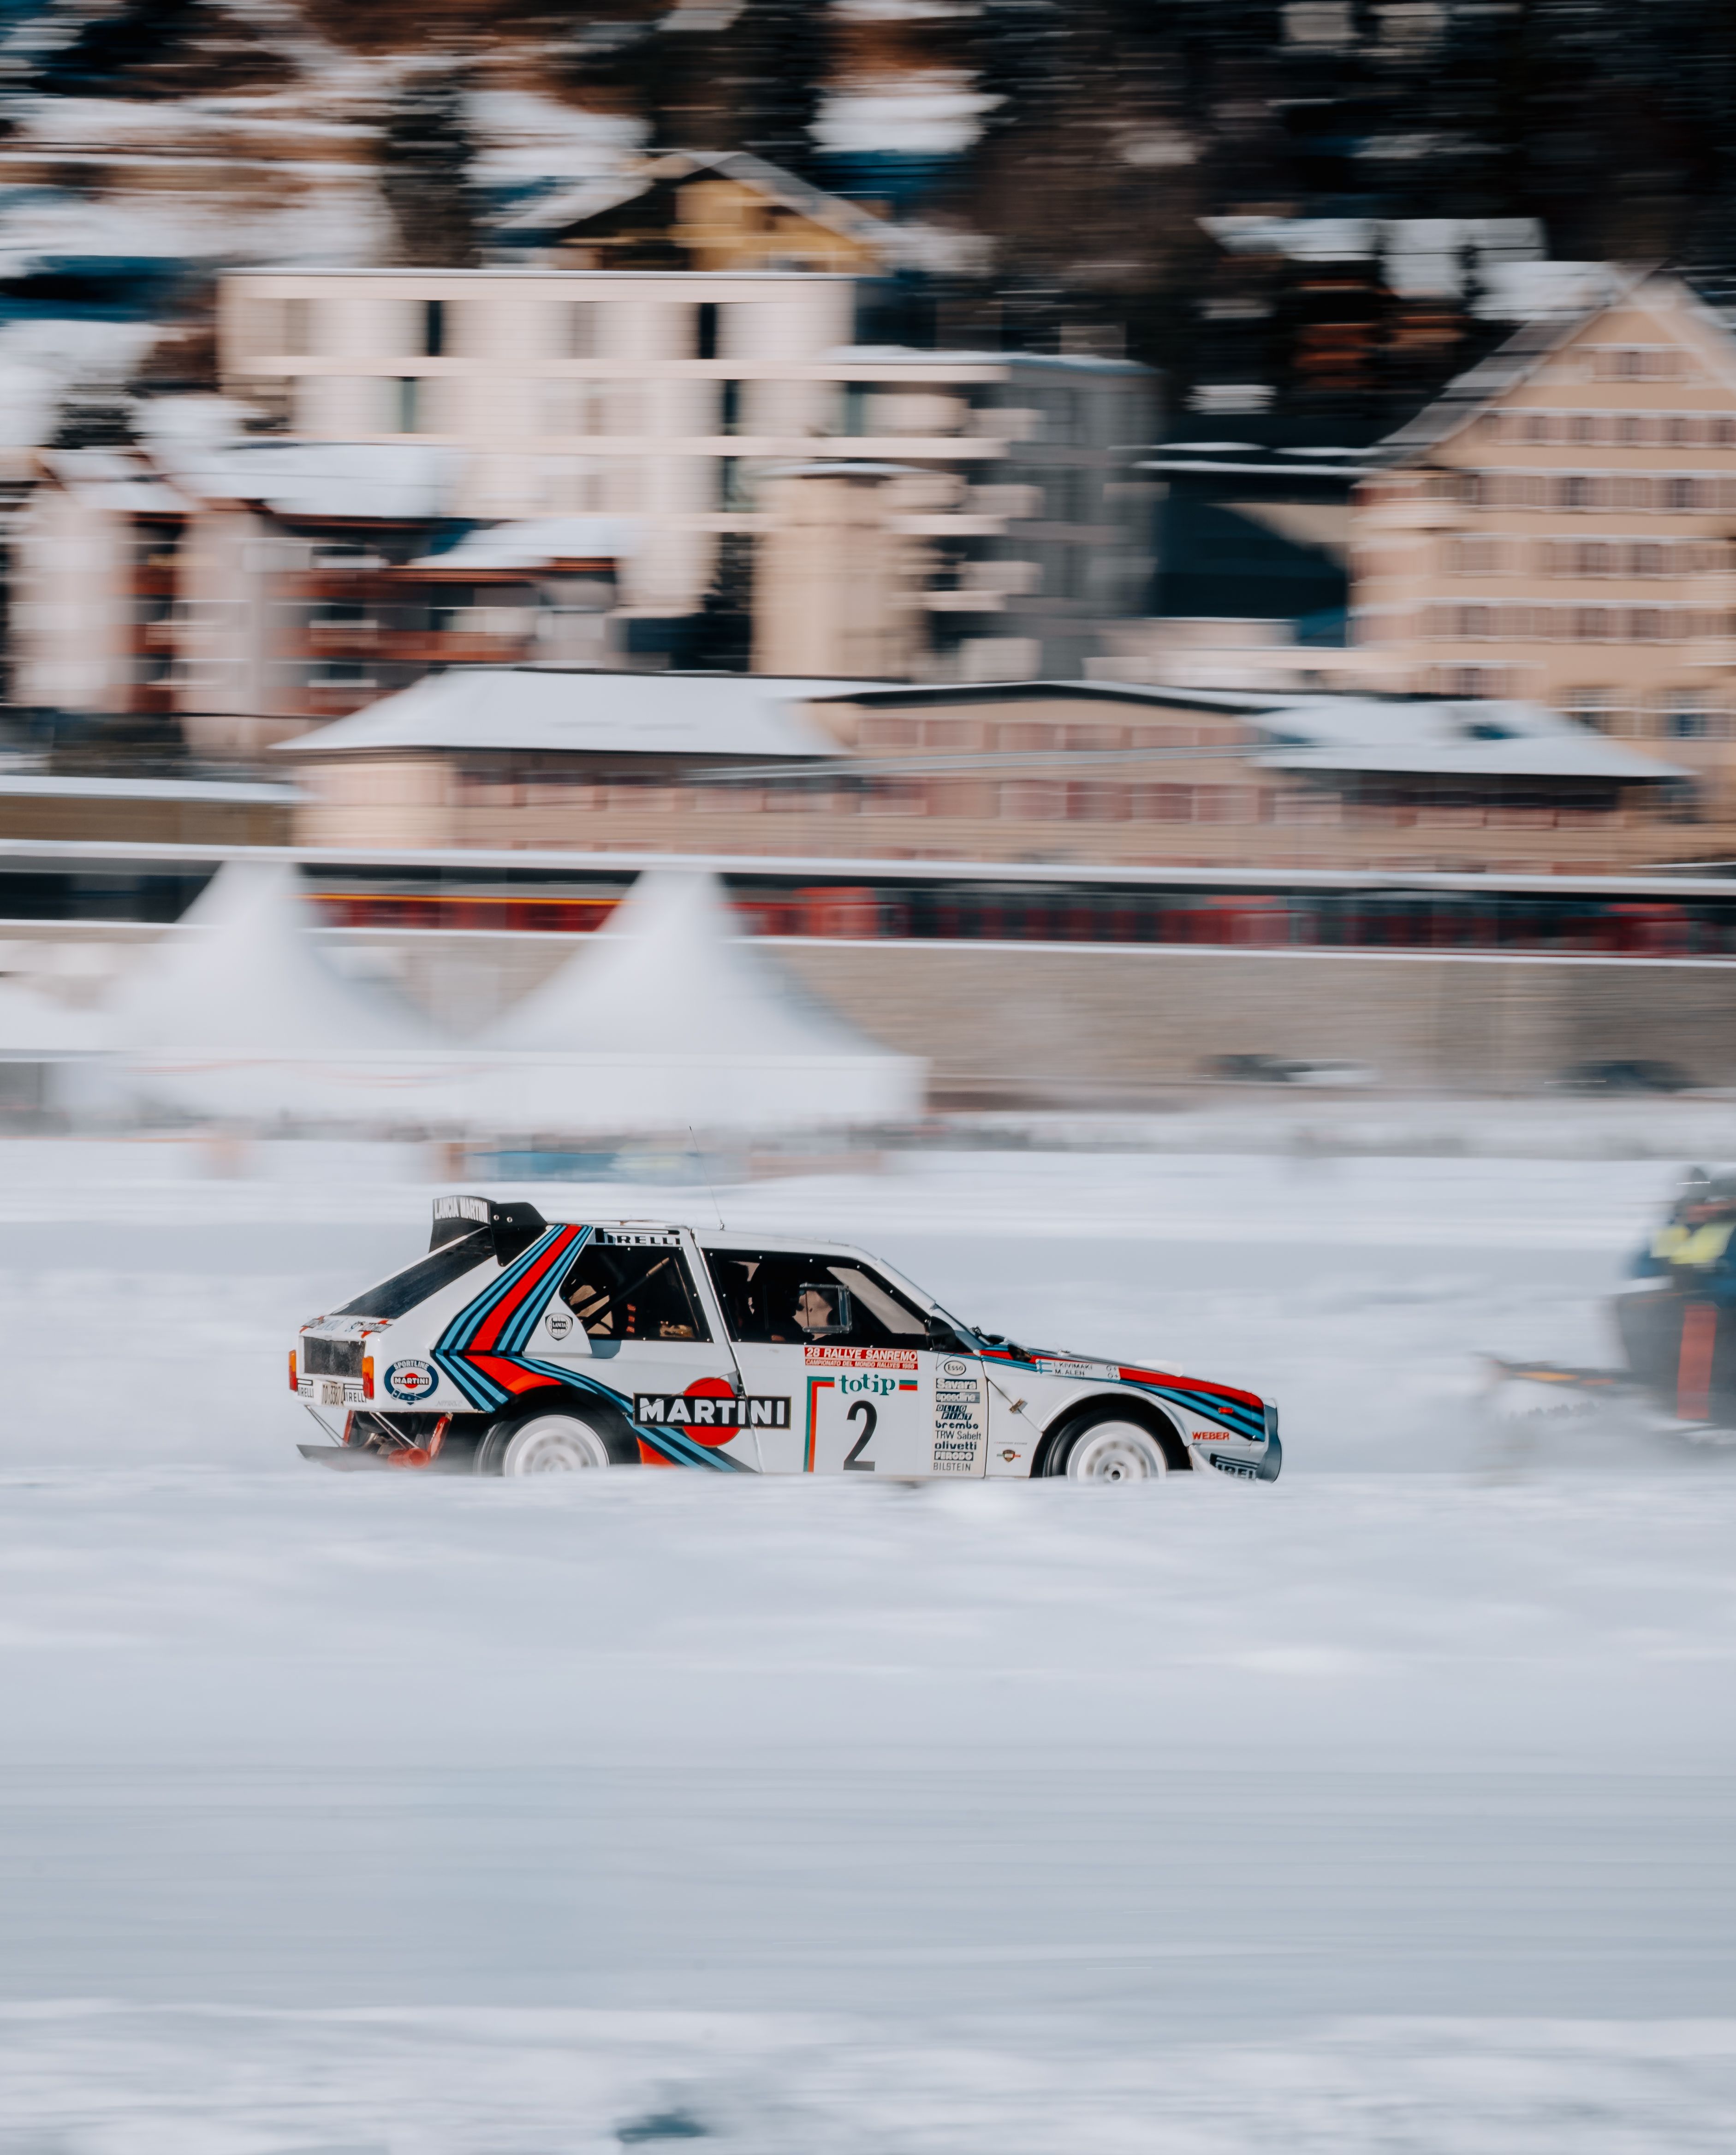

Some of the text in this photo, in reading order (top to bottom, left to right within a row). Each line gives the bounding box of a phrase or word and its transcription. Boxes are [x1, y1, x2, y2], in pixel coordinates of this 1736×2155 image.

[595, 1227, 681, 1244] PIRELLI
[806, 1347, 917, 1361] 28 RALLYE SANREMO
[393, 1360, 429, 1370] SPORTLINE
[838, 1374, 896, 1396] totip
[937, 1378, 976, 1389] Savara
[936, 1392, 976, 1402] speedline
[640, 1398, 785, 1424] MARTINI
[935, 1420, 979, 1429] brembo
[844, 1400, 877, 1471] 2
[935, 1430, 981, 1440] TRW Sabelt
[1192, 1432, 1230, 1440] WEBER
[934, 1441, 977, 1450] olivetti
[935, 1451, 973, 1460] FERODO
[933, 1462, 971, 1471] BILSTEIN
